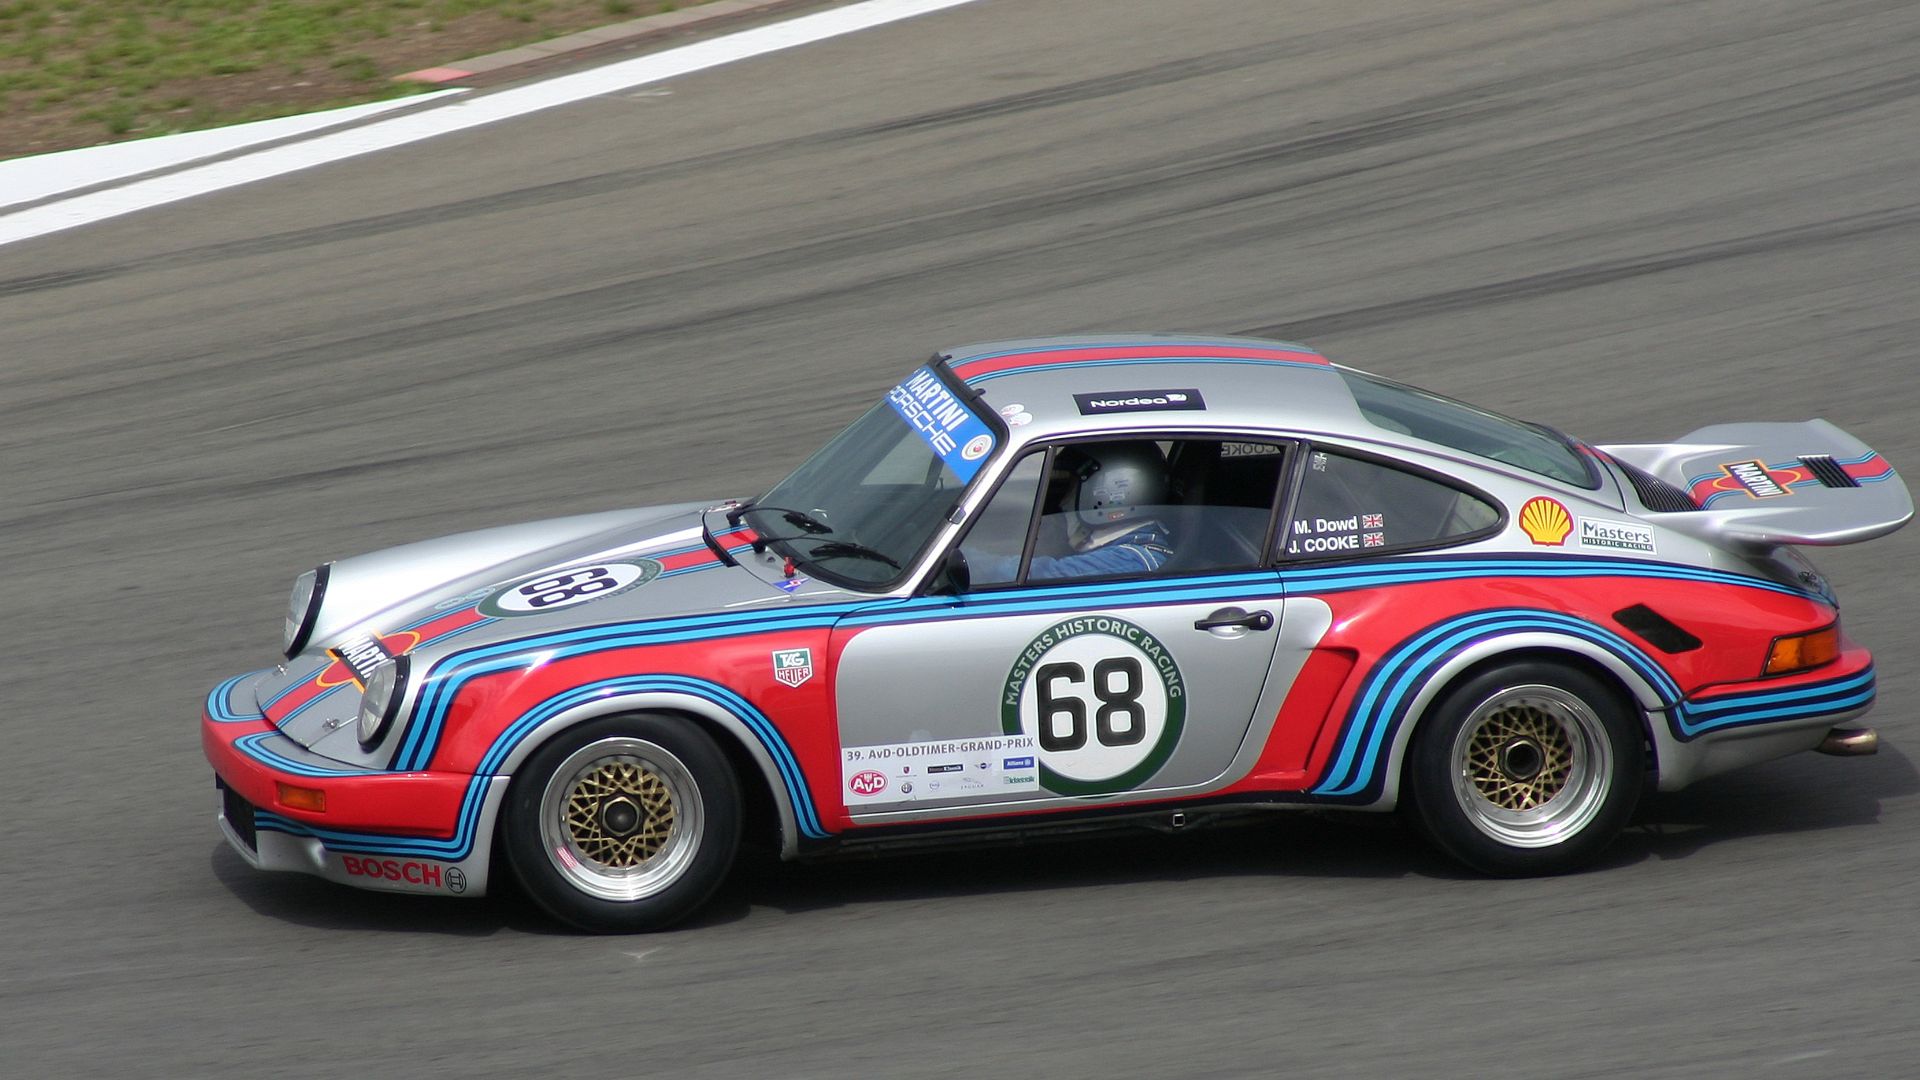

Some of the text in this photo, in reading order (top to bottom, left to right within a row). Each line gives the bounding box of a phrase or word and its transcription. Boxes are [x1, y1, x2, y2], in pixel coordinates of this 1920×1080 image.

[905, 370, 969, 432] MARTINI
[1090, 397, 1168, 408] Nordea
[1730, 462, 1784, 496] MARTINI
[1294, 516, 1358, 535] M. Dowd
[1583, 521, 1650, 543] Masters
[1289, 536, 1360, 554] J. COOKE
[1583, 538, 1653, 551] HISTORIC RACING
[518, 567, 619, 608] 68
[338, 633, 389, 679] MARTI
[780, 653, 805, 668] TAG
[1006, 618, 1182, 706] MASTERS HISTORIC RACING
[778, 668, 809, 684] HEUER
[1036, 656, 1147, 753] 68
[847, 737, 1034, 760] 39. AvD-OLDTIMER-GRAND-PRIX
[342, 855, 442, 887] BOSCH
